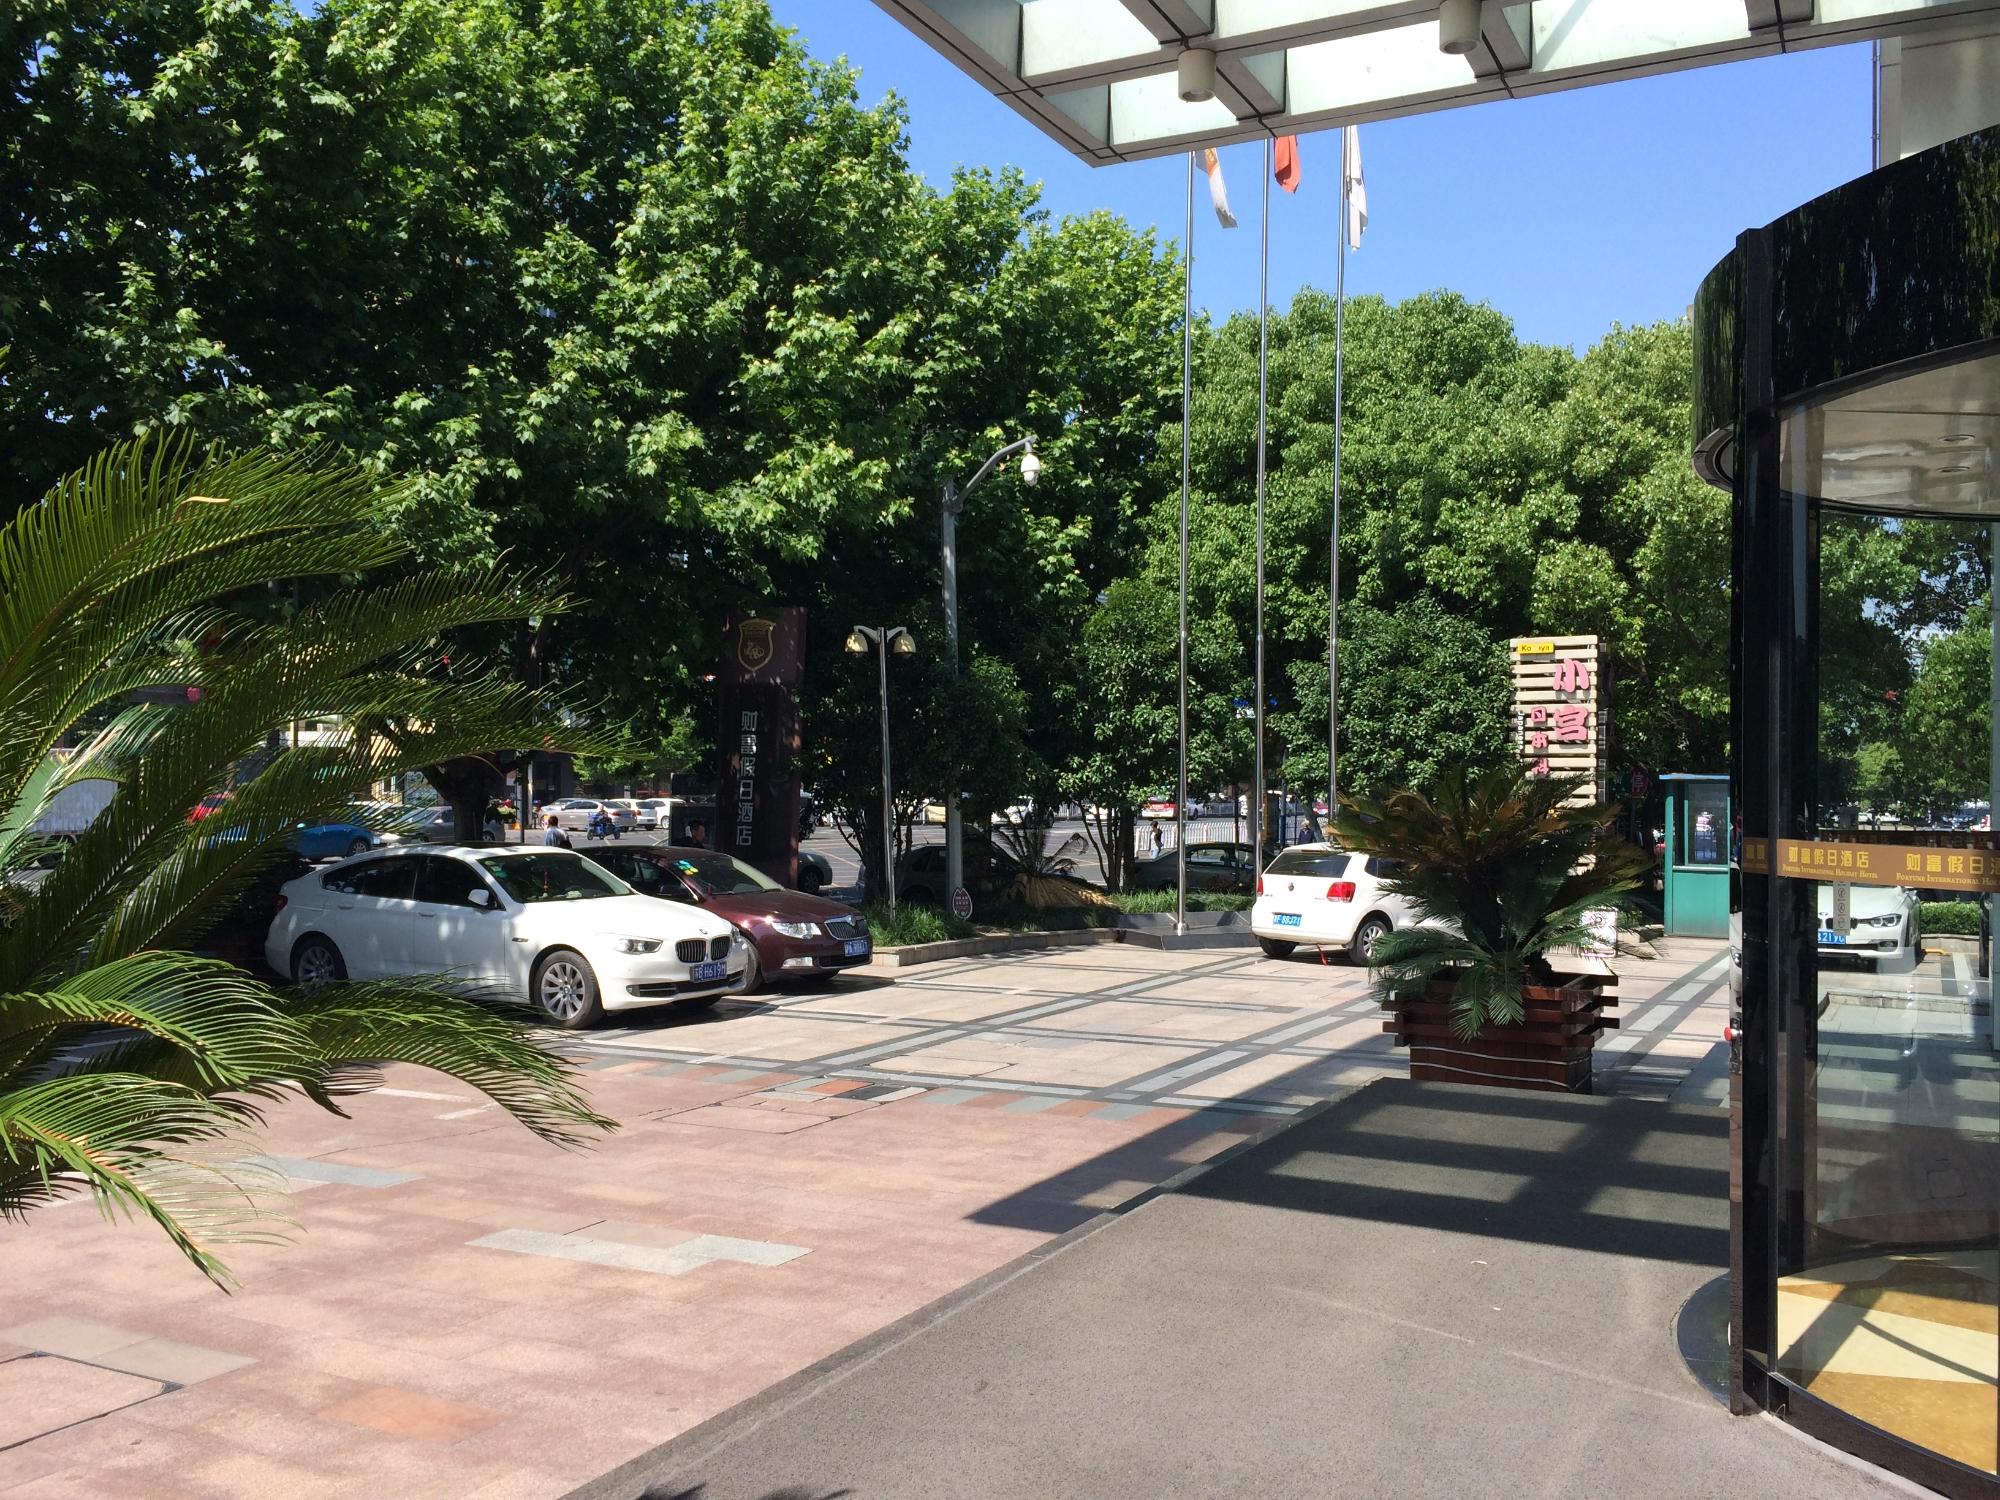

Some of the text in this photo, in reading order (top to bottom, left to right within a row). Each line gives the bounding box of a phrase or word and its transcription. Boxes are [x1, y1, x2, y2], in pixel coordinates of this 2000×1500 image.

[735, 710, 758, 846] 财富假日酒店
[1788, 846, 1869, 869] 财富假日酒店
